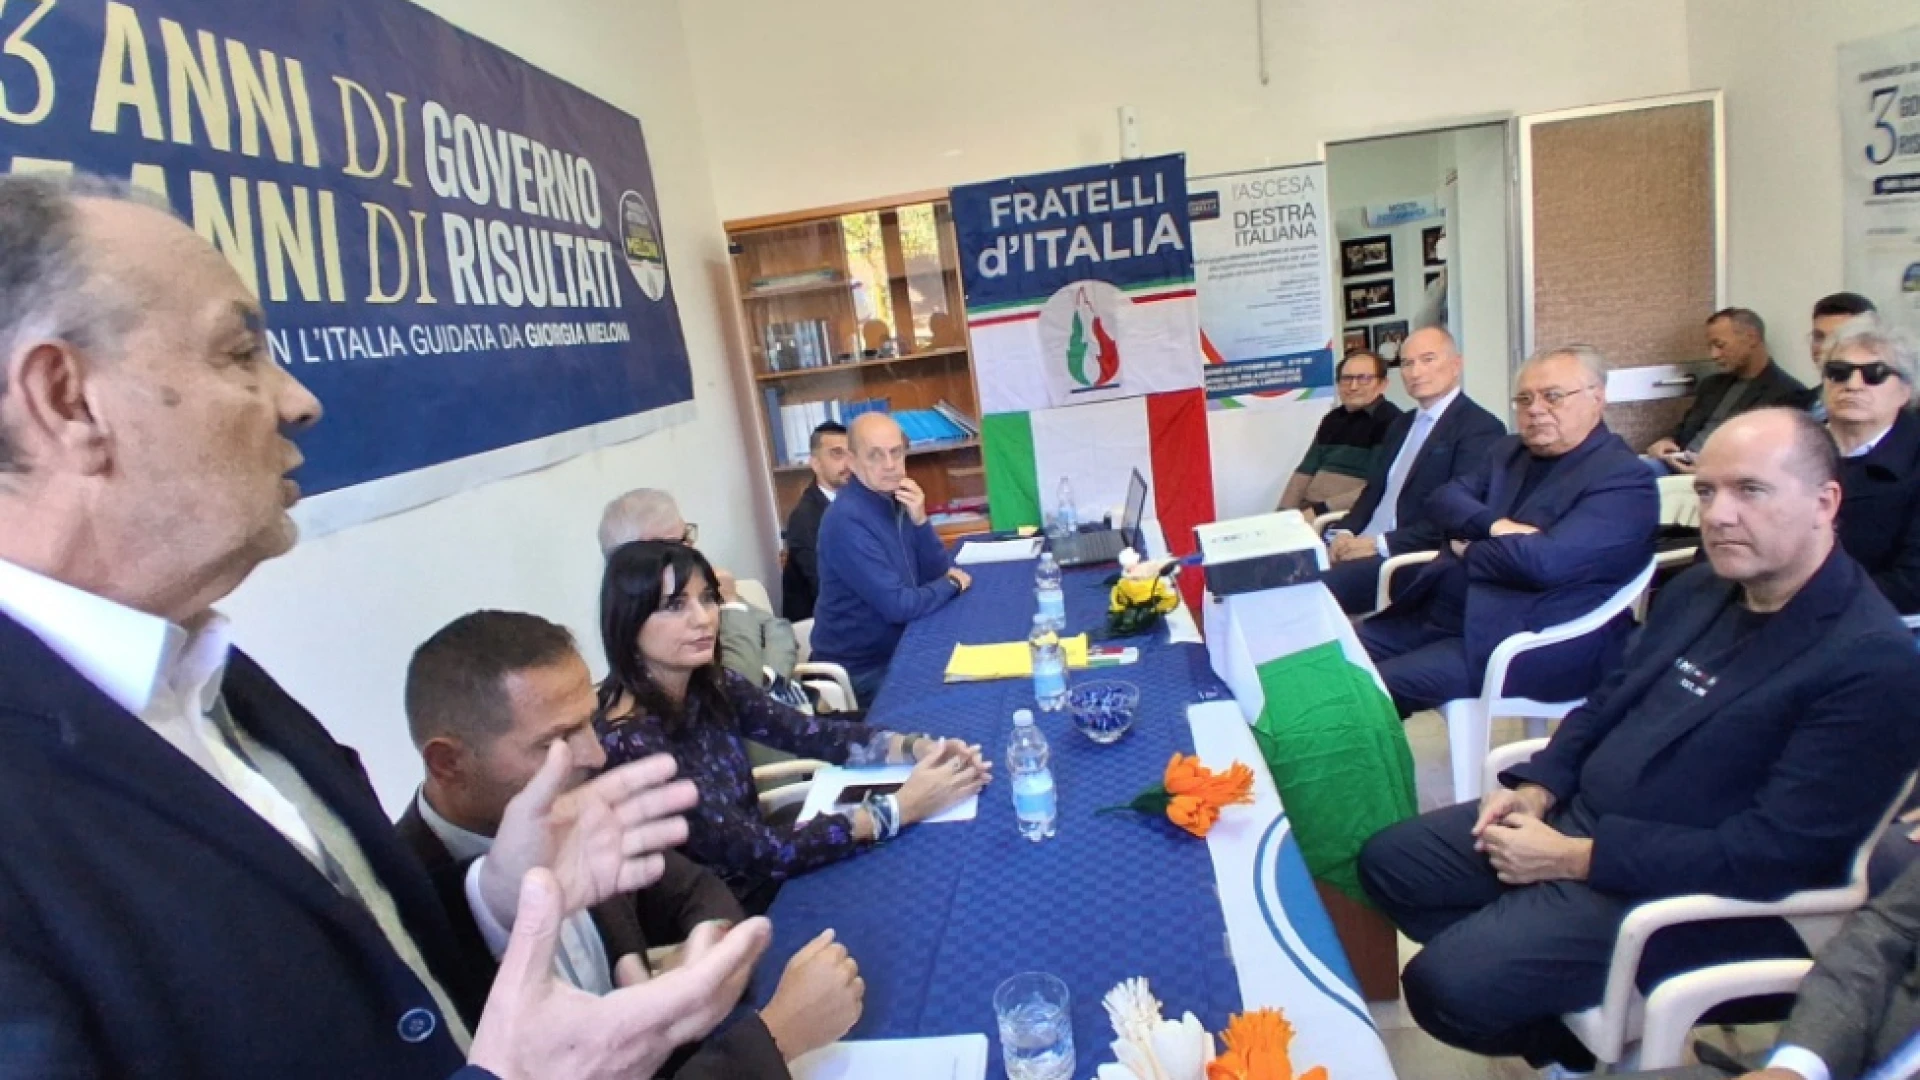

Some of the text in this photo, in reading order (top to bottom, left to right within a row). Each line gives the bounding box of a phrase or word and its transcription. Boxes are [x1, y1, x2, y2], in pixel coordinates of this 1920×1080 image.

[0, 0, 602, 229] 3 ANNI DI GOVERNO
[1864, 85, 1898, 165] 3
[989, 172, 1165, 228] FRATELLI
[1233, 202, 1316, 229] DESTRA
[131, 162, 622, 308] NNI DI RISULTATI
[977, 213, 1184, 279] d'ITALIA
[1234, 222, 1317, 246] ITALIANA
[299, 326, 407, 363] L'ITALIA
[409, 323, 499, 356] GUIDATA
[499, 323, 525, 350] DA
[525, 322, 586, 348] GIORGIA
[586, 322, 631, 345] MELONI
